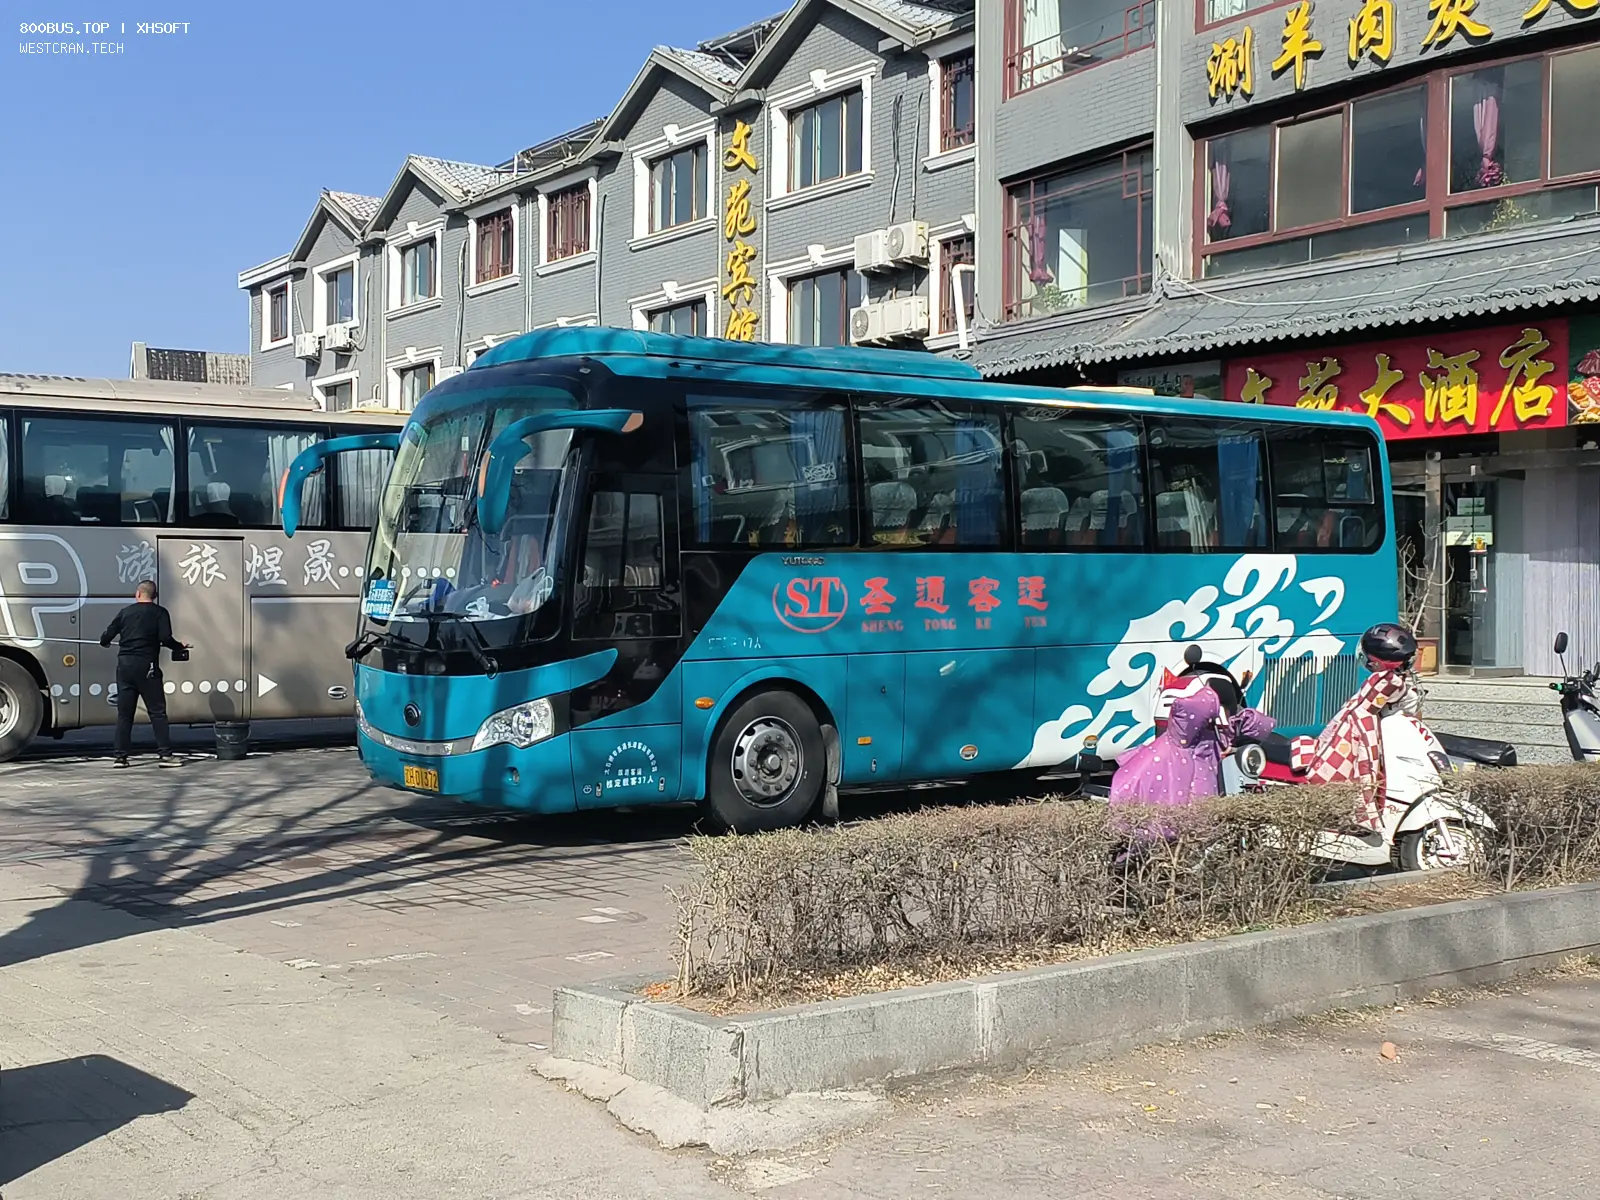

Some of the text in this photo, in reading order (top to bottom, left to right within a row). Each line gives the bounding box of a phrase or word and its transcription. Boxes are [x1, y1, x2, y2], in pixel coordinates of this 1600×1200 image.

[1207, 0, 1600, 98] 涮羊肉炭
[723, 119, 759, 341] 文苑宾馆
[784, 576, 841, 617] ST
[859, 576, 1049, 614] 圣通客运
[924, 618, 957, 631] TONG
